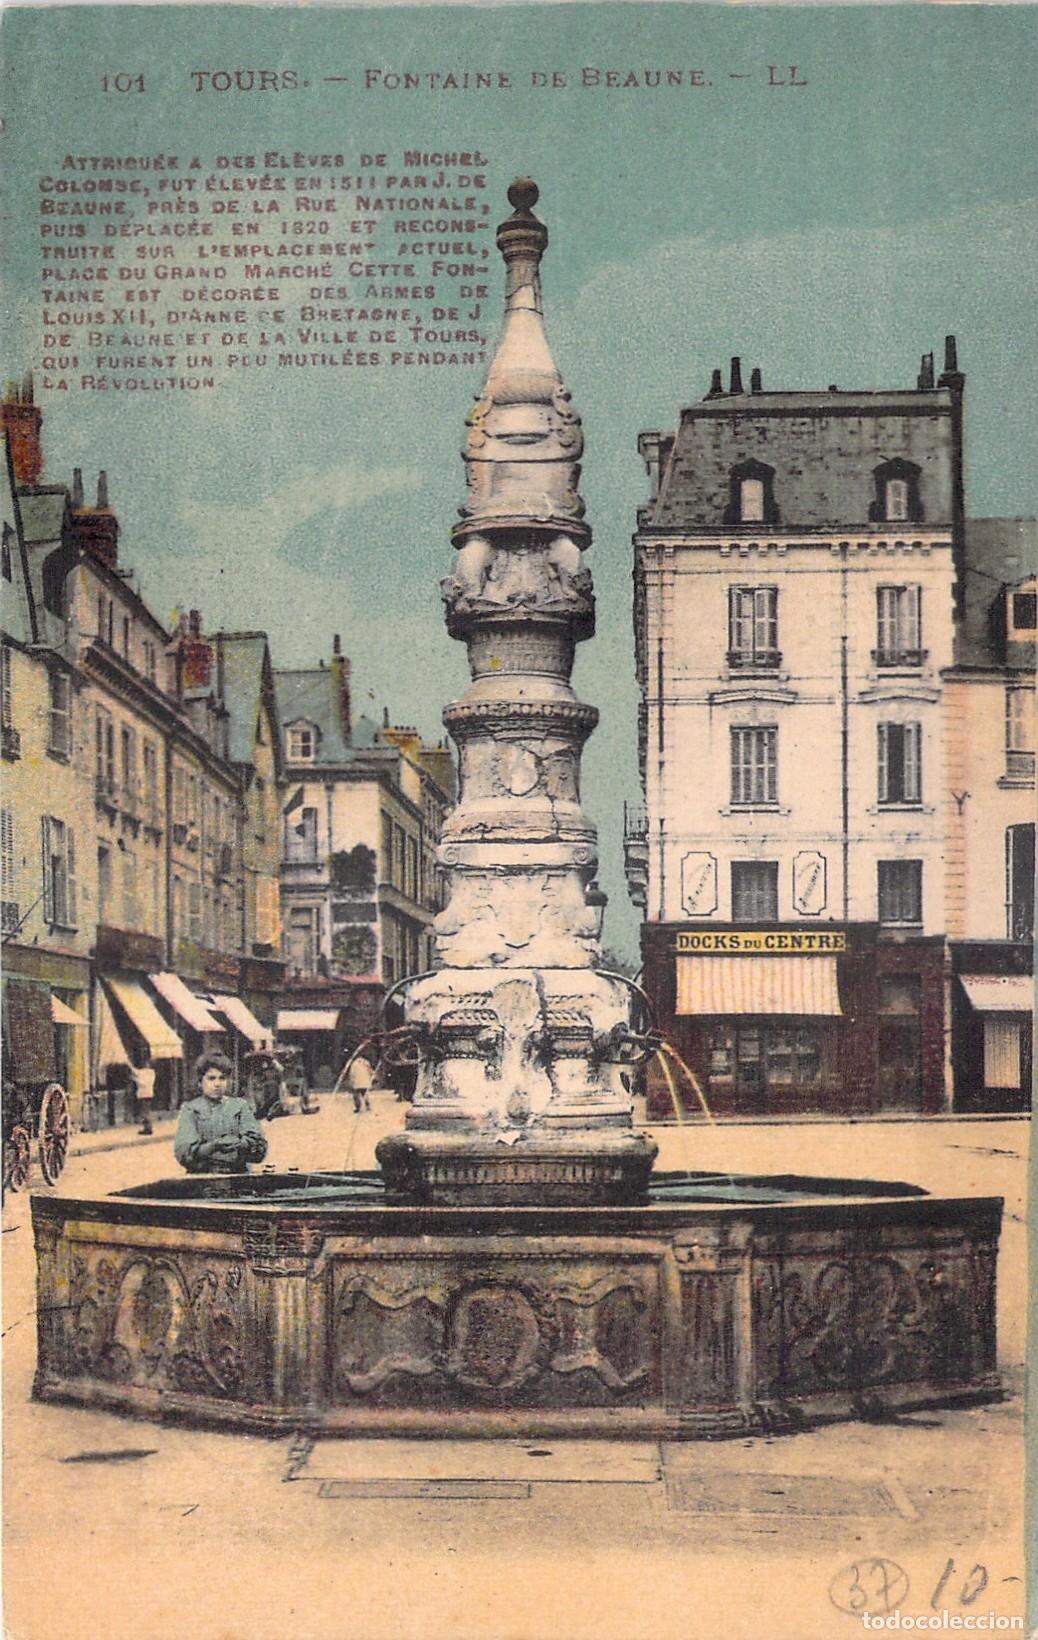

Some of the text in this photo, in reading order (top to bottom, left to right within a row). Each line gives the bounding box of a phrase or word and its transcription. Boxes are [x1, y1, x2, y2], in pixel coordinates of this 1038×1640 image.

[679, 934, 844, 948] DOCKS DU CENTRE
